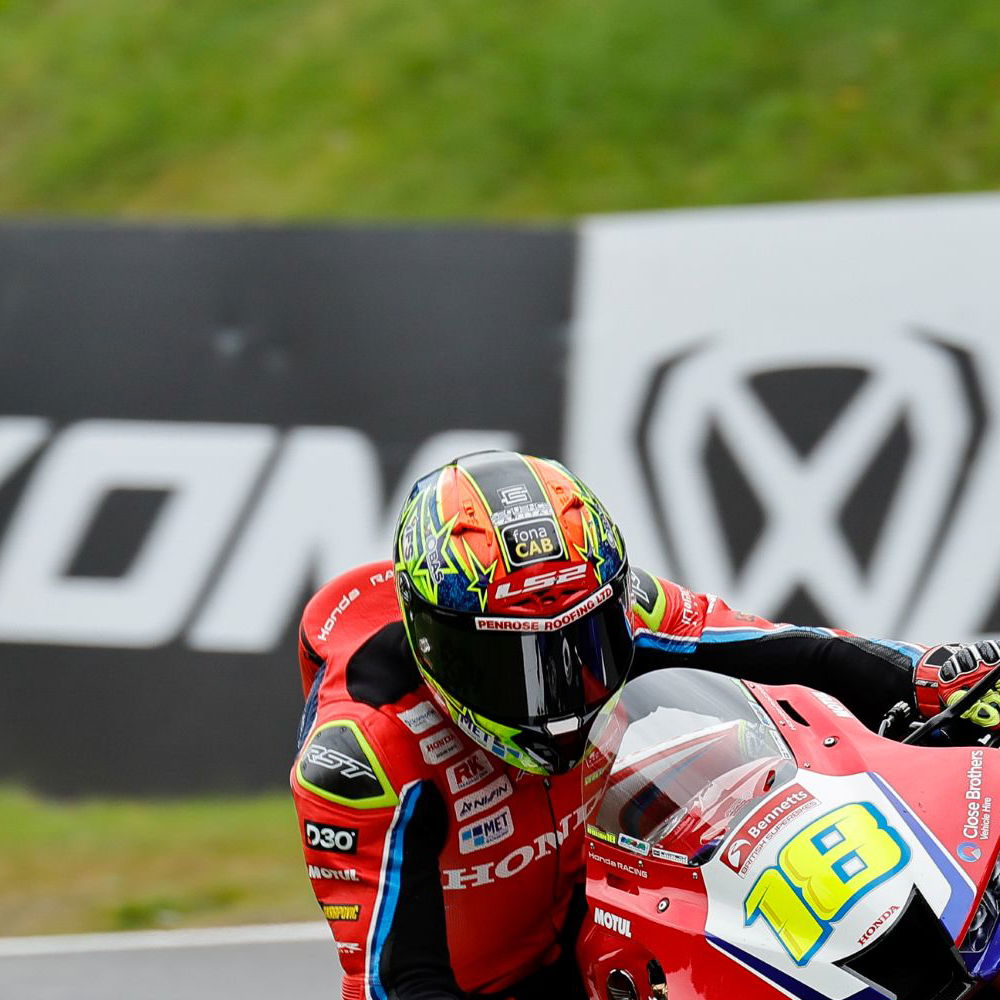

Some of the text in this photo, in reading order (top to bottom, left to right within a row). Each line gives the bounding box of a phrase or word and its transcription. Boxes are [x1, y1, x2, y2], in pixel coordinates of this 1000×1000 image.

[513, 527, 547, 543] fona
[515, 538, 554, 558] CAB
[495, 564, 588, 599] LS2
[318, 588, 361, 641] Honda
[478, 620, 539, 631] PENROSE
[544, 601, 595, 631] ROOFING
[596, 587, 613, 604] LTD
[307, 744, 377, 781] RST
[453, 757, 485, 785] RK
[963, 750, 984, 839] Close Brothers
[483, 812, 508, 837] MET
[747, 790, 808, 839] Bennetts
[980, 797, 992, 840] Vehicle Hire
[308, 864, 360, 881] MOTUL
[588, 852, 648, 879] Honda RACING
[743, 801, 911, 967] 18
[594, 907, 632, 938] MOTUL
[857, 904, 901, 946] HONDA
